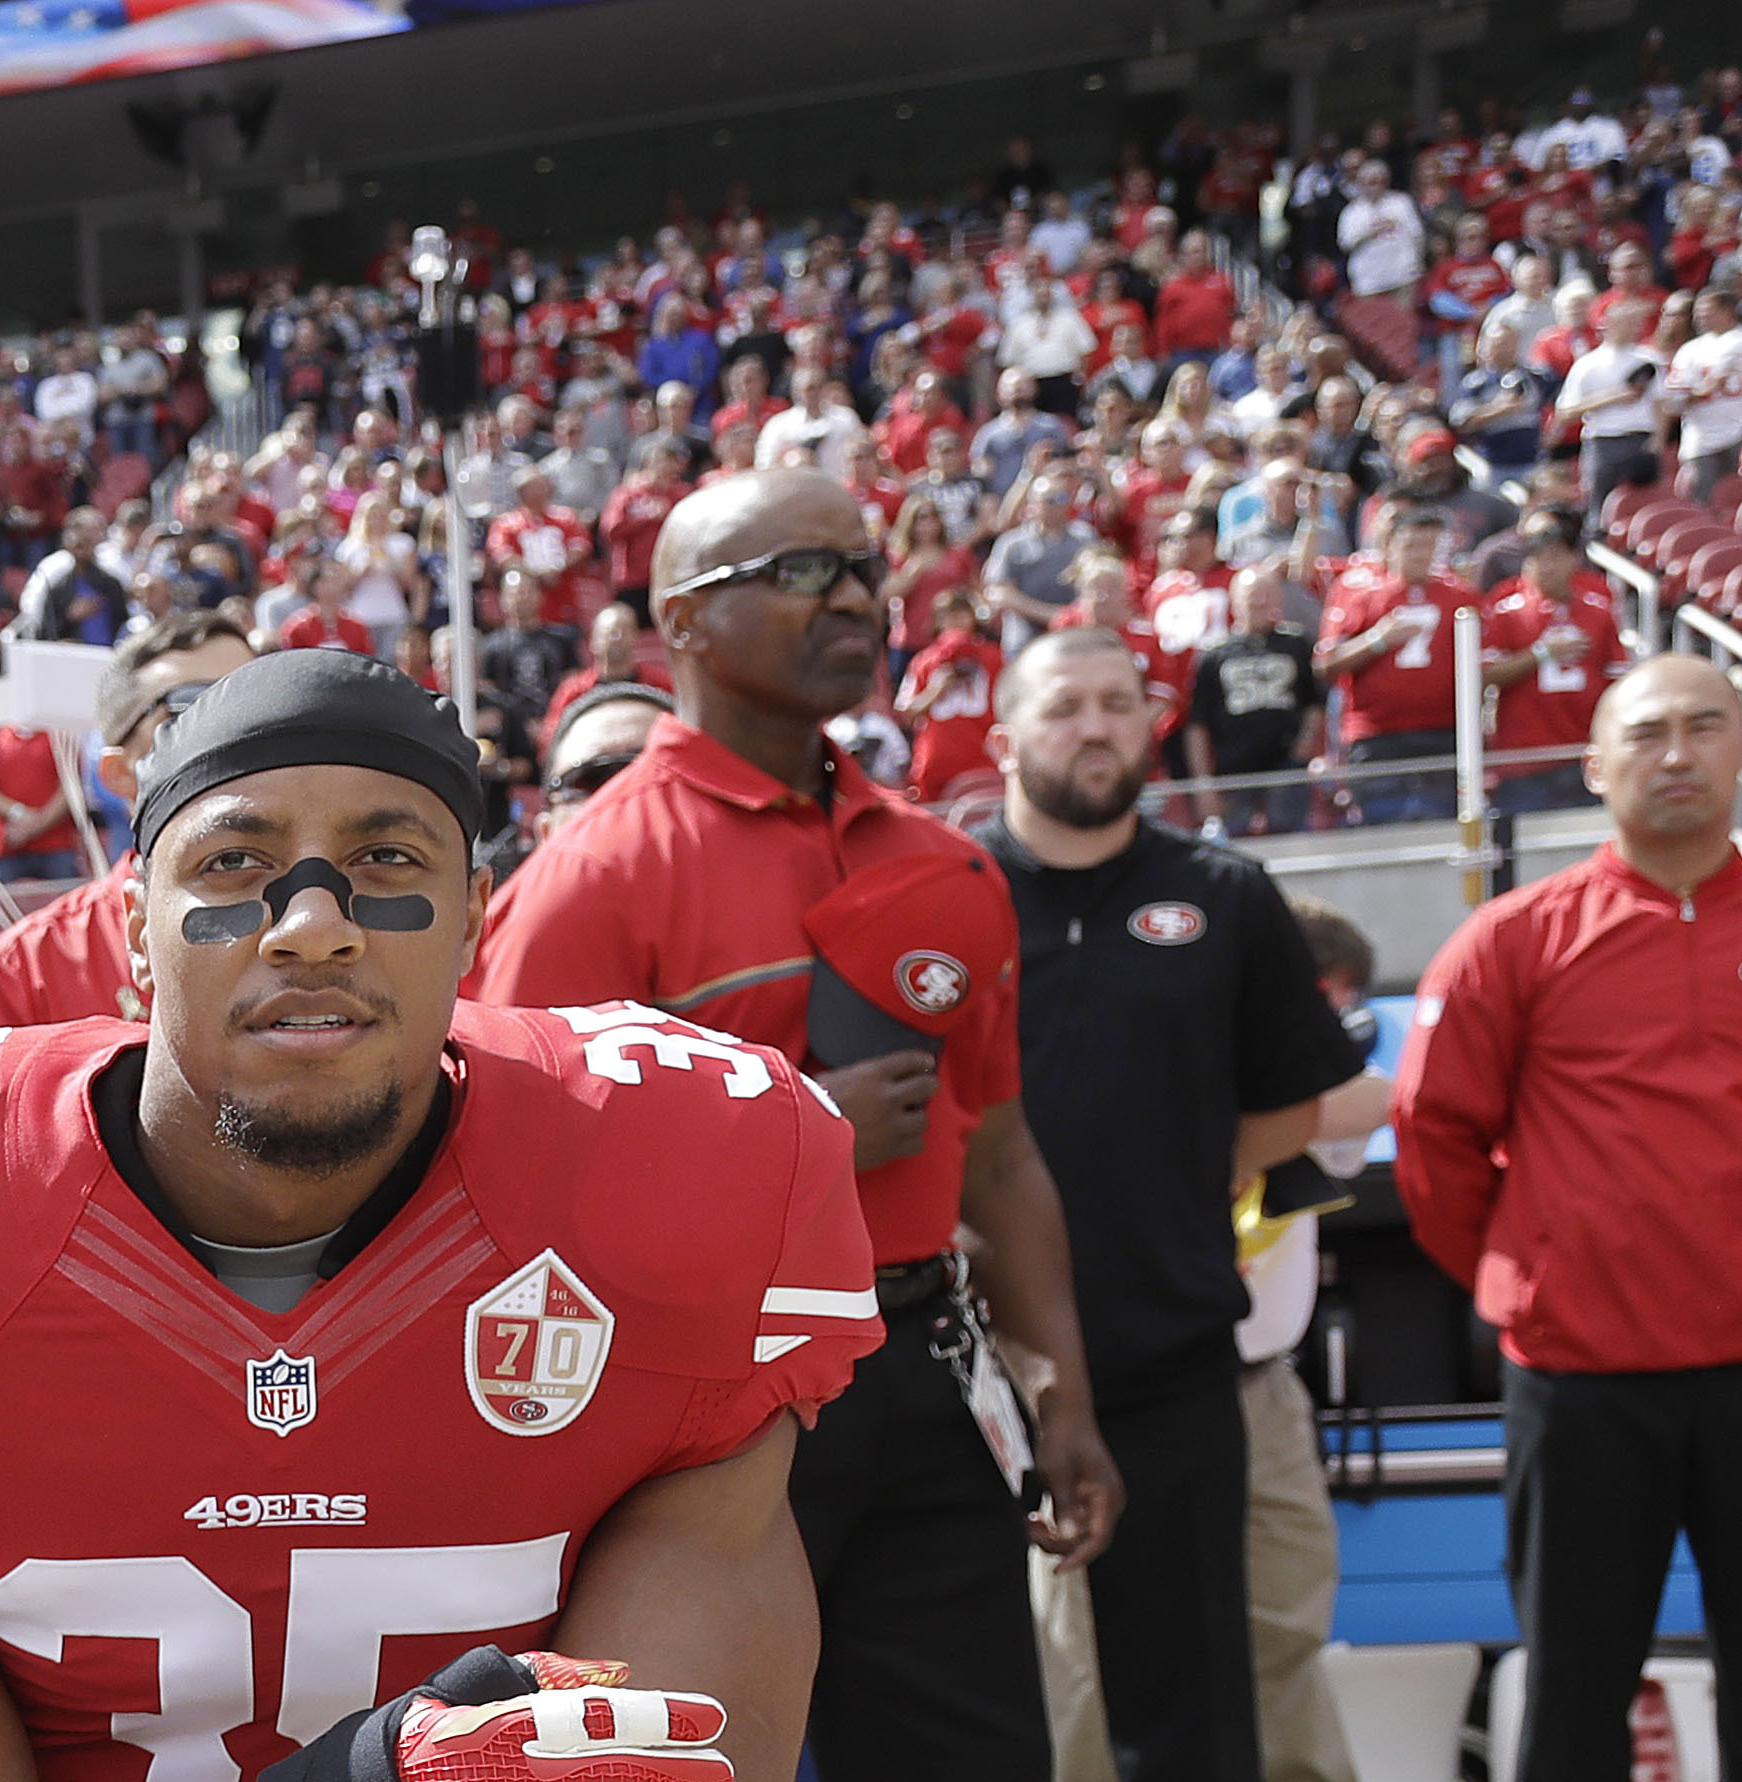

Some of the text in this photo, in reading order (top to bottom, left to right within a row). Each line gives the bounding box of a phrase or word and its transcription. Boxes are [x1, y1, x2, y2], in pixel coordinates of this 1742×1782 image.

[1394, 604, 1441, 669] 7
[494, 1322, 584, 1380] 70
[259, 1387, 305, 1420] NFL
[499, 1382, 568, 1397] YEARS
[183, 1493, 368, 1530] 49ERS
